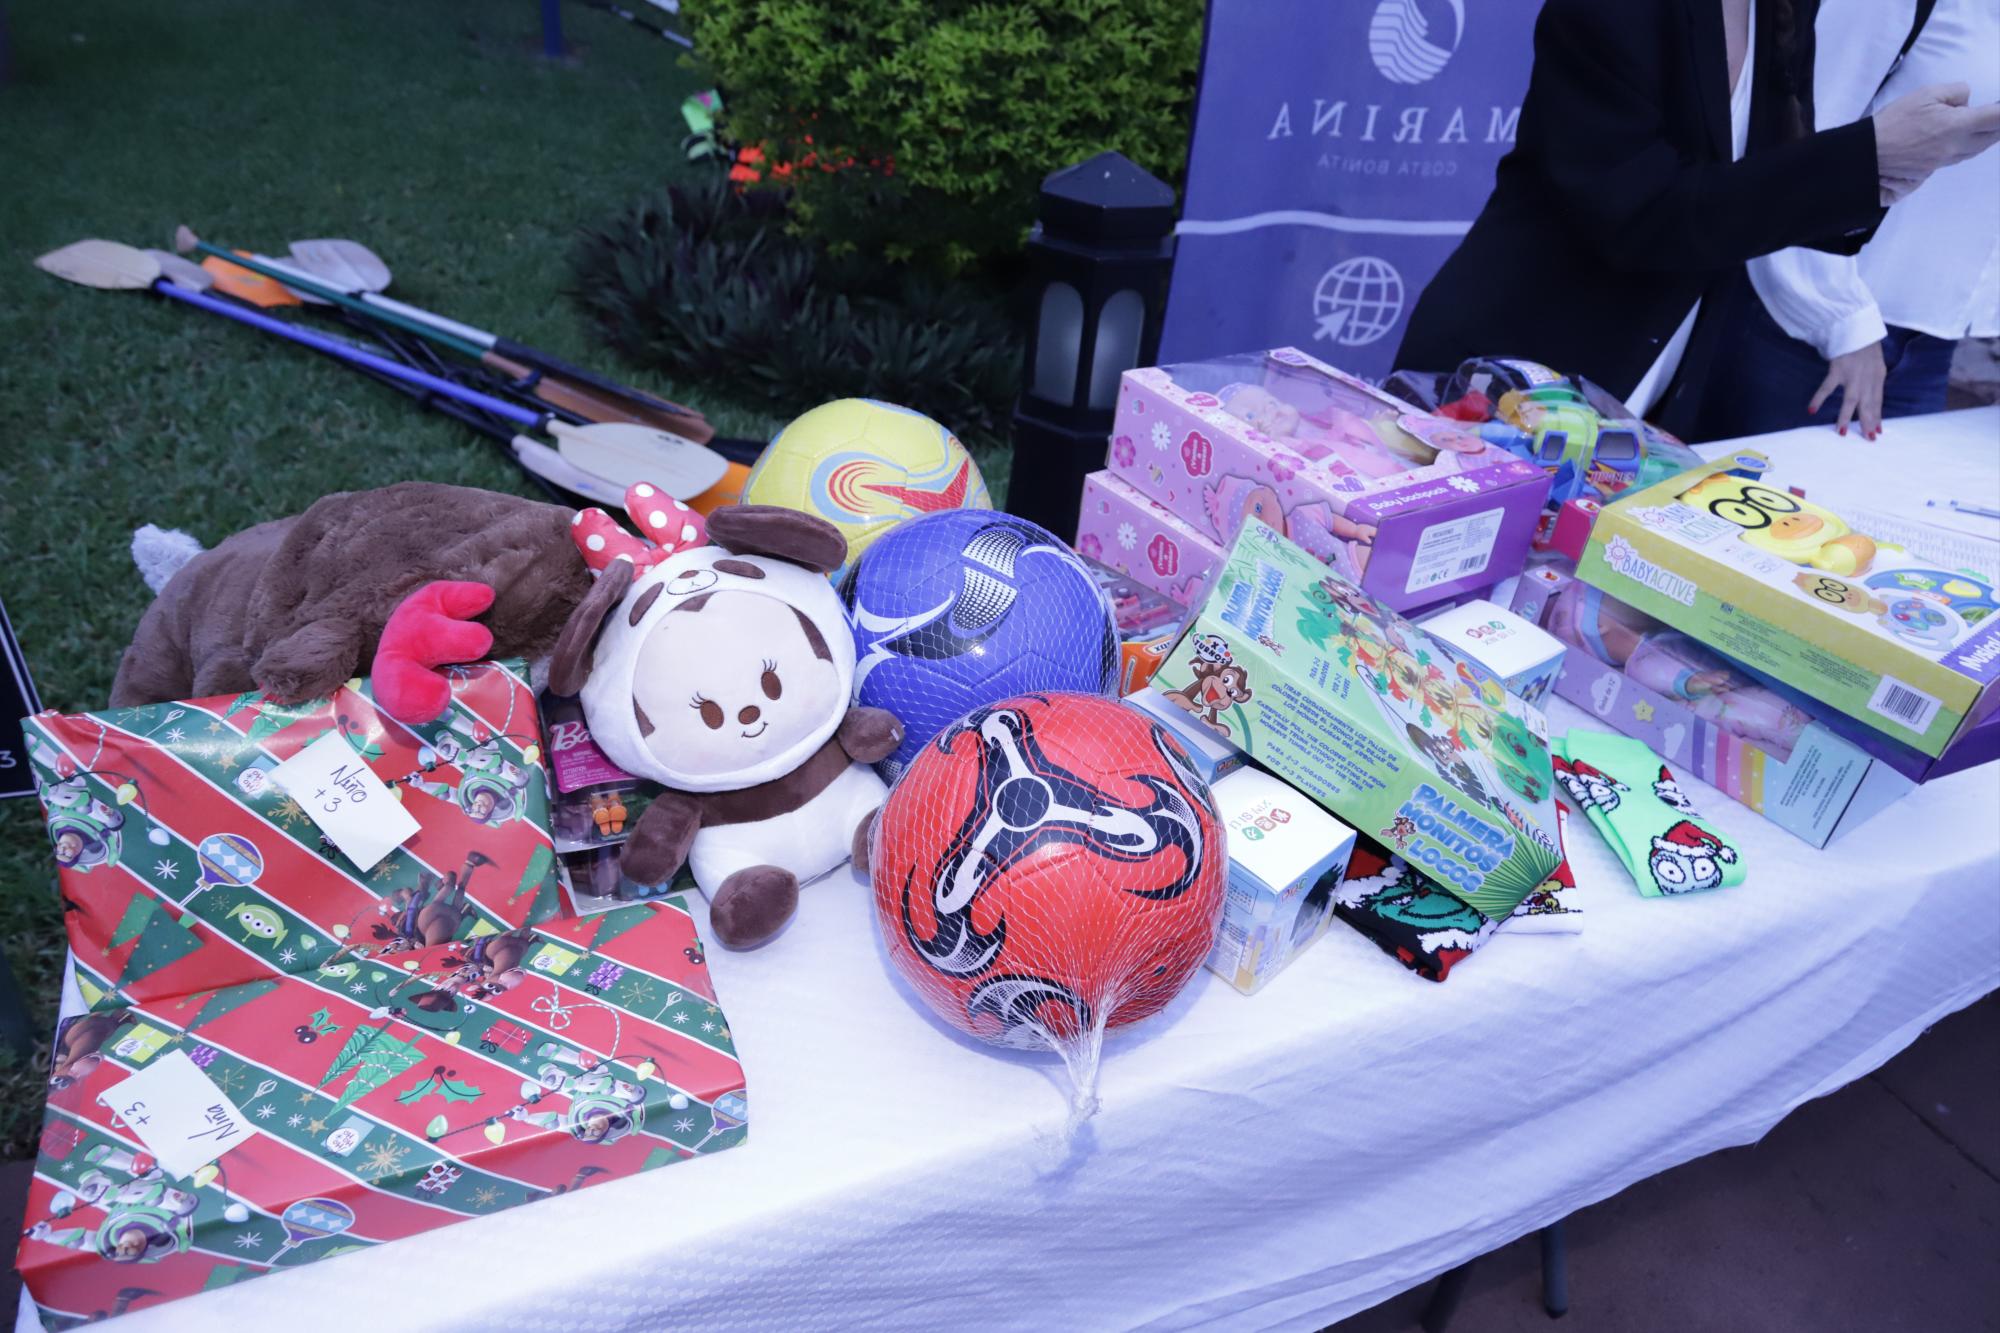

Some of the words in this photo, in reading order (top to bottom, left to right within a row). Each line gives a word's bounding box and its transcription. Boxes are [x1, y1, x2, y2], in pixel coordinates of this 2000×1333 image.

[1220, 582, 1254, 631] PALMERA
[1243, 590, 1274, 641] MONITOS
[1193, 640, 1227, 664] TURNOS
[1271, 684, 1298, 704] COLORES
[1329, 723, 1352, 741] TRONCO
[1283, 701, 1295, 711] LOS
[1296, 709, 1317, 725] MONOS
[1283, 683, 1301, 697] TIRAR
[1355, 731, 1366, 741] LOS
[1368, 740, 1385, 754] PALOS
[1290, 722, 1304, 734] PULL
[1306, 733, 1317, 743] THE
[1266, 755, 1279, 766] FOR
[1282, 765, 1294, 775] 2-3
[1266, 741, 1284, 755] PARA
[1286, 755, 1298, 765] 2-3
[1300, 764, 1340, 793] JUGADORES
[1289, 730, 1308, 745] TRUNK
[1310, 744, 1334, 763] WITHOUT
[1312, 754, 1323, 763] OUT
[330, 764, 368, 803] Niño
[1399, 800, 1503, 873] MONITOS
[1412, 783, 1516, 860] PALMERA
[1408, 839, 1484, 893] LOCOS
